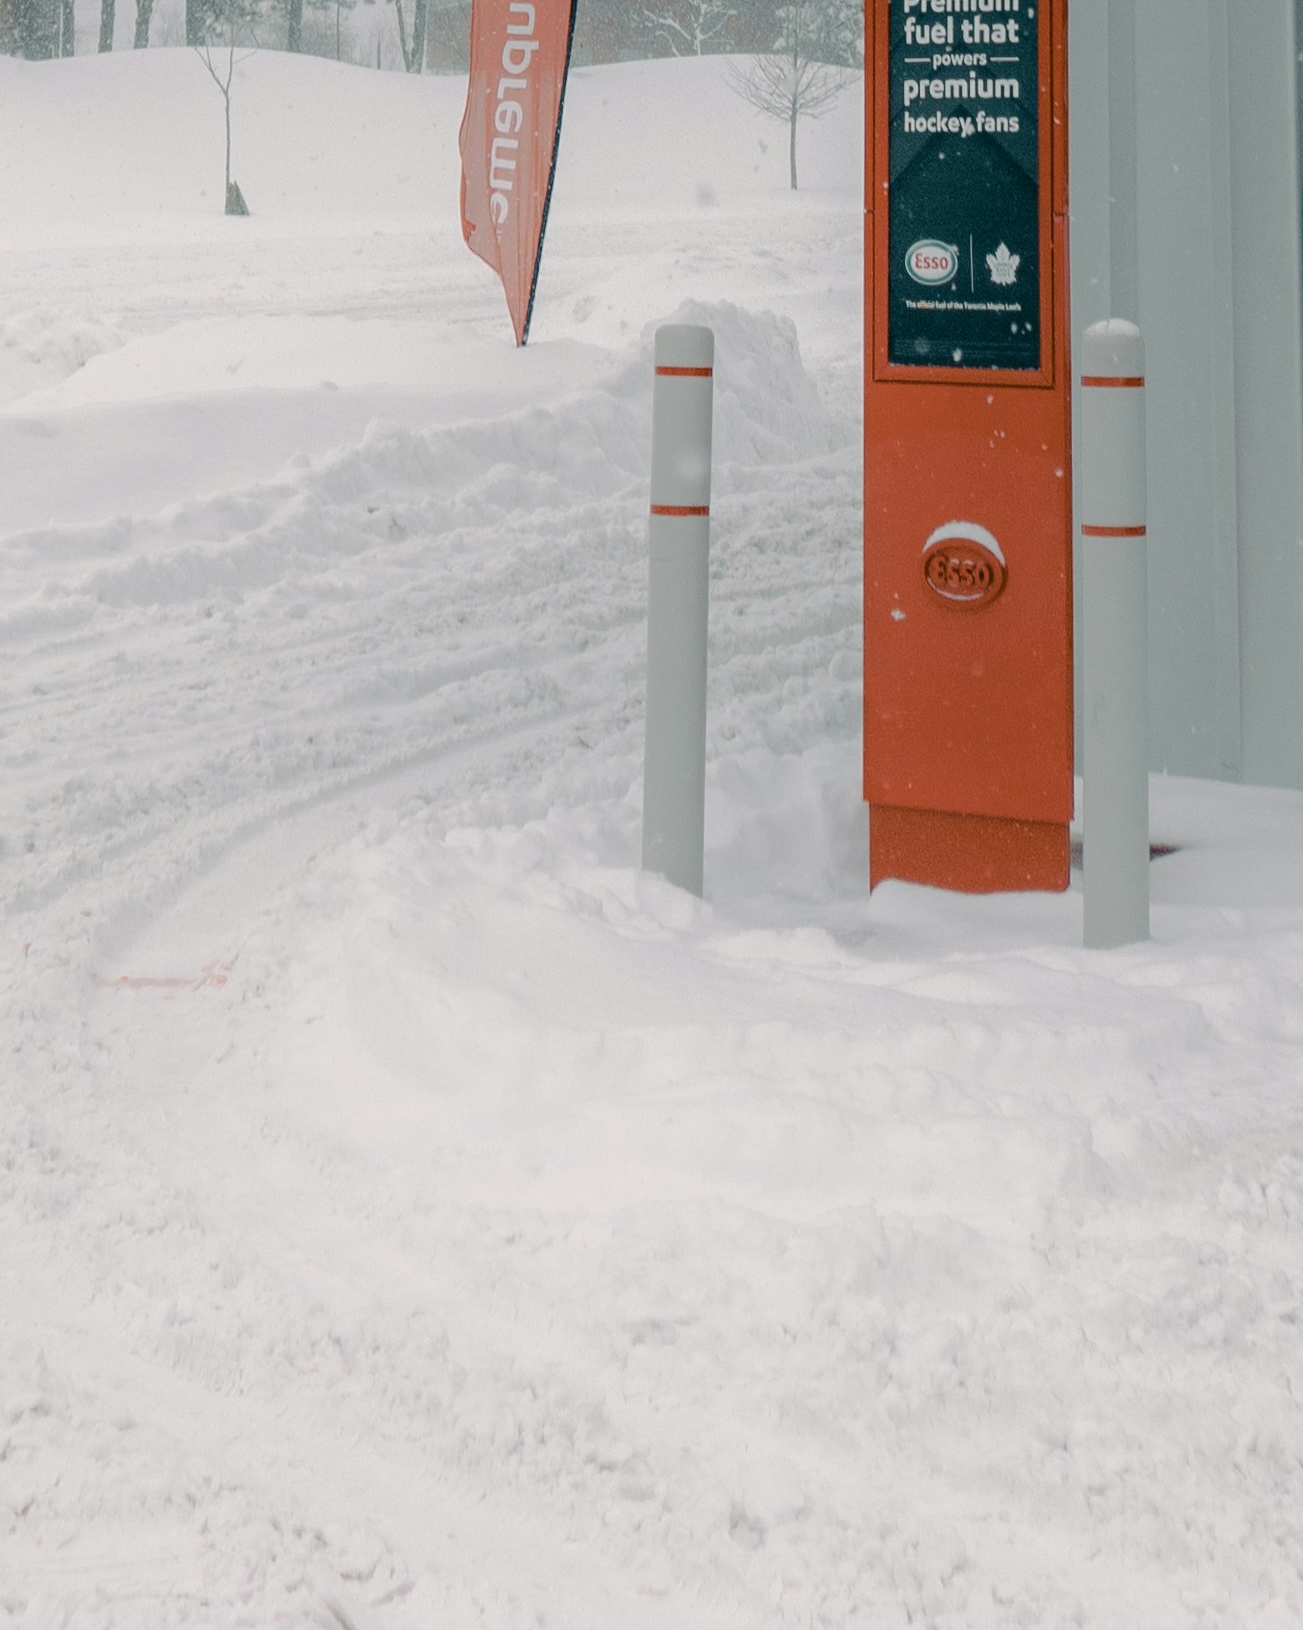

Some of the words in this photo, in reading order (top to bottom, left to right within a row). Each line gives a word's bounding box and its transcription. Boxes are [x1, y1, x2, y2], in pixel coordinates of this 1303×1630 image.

[903, 16, 954, 45] fuel
[961, 14, 1020, 44] that
[932, 53, 987, 71] powers
[903, 70, 1020, 107] premium
[903, 110, 973, 138] hockey
[976, 110, 1020, 133] fans
[914, 252, 949, 270] Esso
